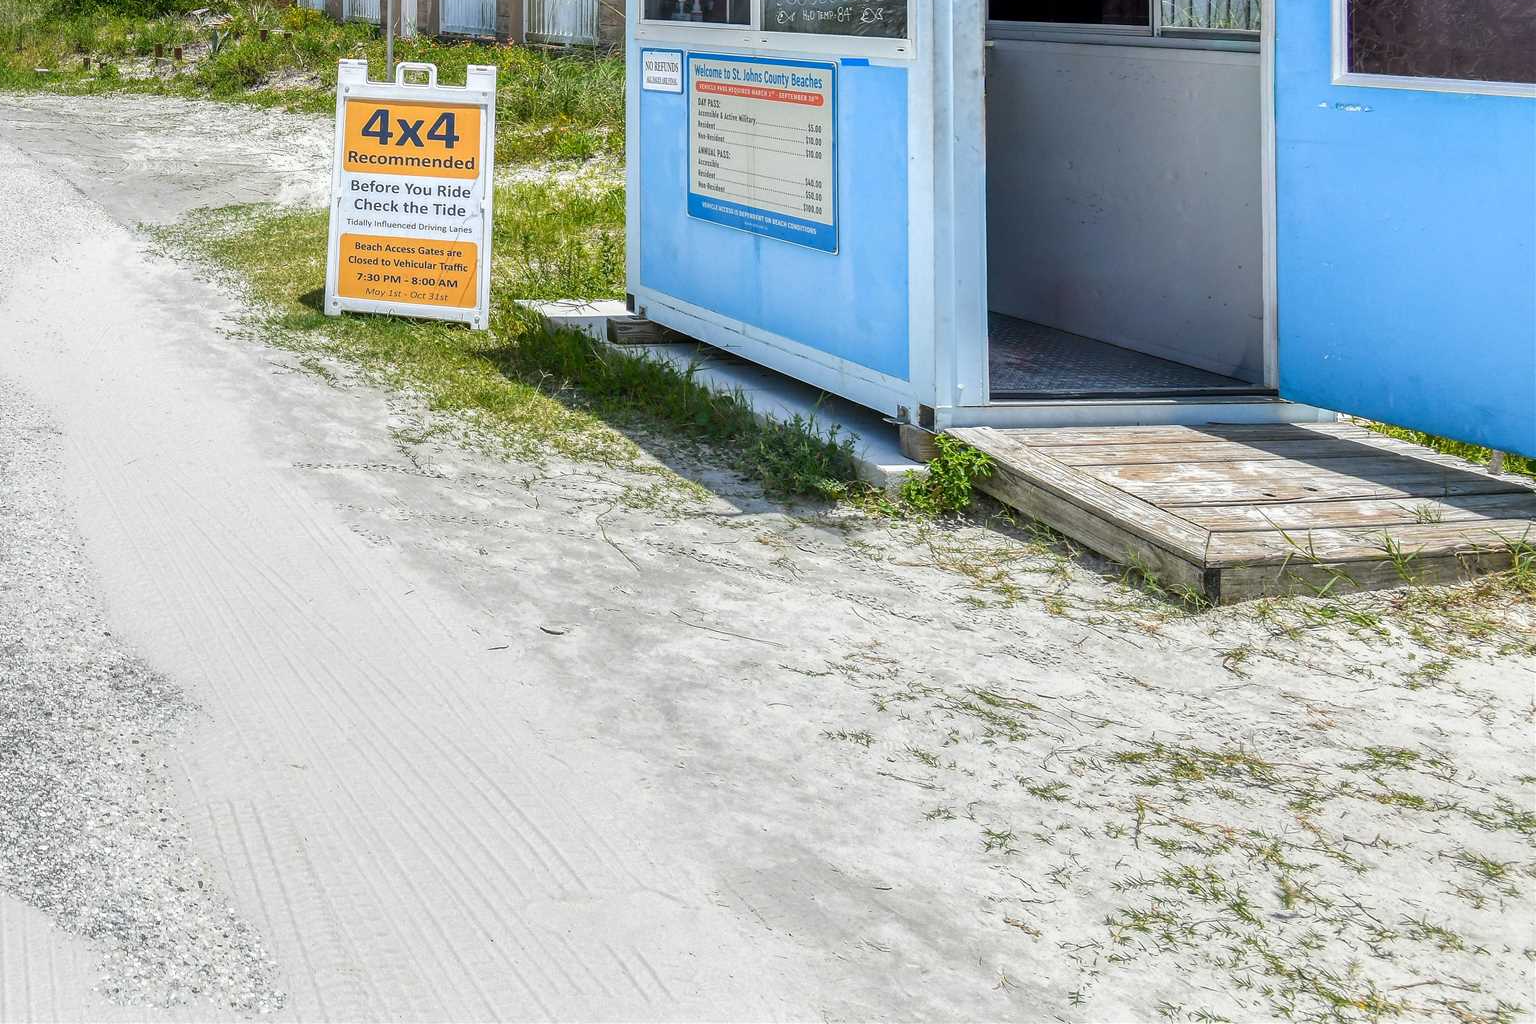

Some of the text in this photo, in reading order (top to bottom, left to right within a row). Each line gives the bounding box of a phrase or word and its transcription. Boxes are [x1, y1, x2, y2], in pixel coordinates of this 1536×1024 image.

[646, 61, 678, 72] NO REFUNDS
[695, 64, 823, 89] Welcome to St. Johns County Beaches
[708, 99, 720, 108] PASS:
[779, 93, 807, 101] SEPTEMBER
[698, 110, 719, 118] Accessible
[724, 113, 738, 121] Active
[362, 109, 459, 149] 4x4
[698, 120, 715, 130] Resident
[348, 151, 475, 170] Recommended
[717, 149, 731, 159] PASS:
[698, 169, 715, 179] Resident
[351, 180, 471, 198] Before You Ride
[354, 198, 466, 217] Check the Tide
[347, 218, 472, 233] Tidally Influenced Driving Lanes
[355, 242, 462, 257] Beach Access Gates are
[349, 256, 468, 272] Closed to Vehicular Traffic
[357, 273, 380, 282] 7:30
[384, 274, 401, 283] PM
[411, 276, 435, 286] 8:00
[438, 279, 458, 288] AM
[365, 288, 385, 298] May
[388, 289, 401, 299] 1st
[411, 290, 425, 300] Oct
[428, 292, 448, 302] 31st
